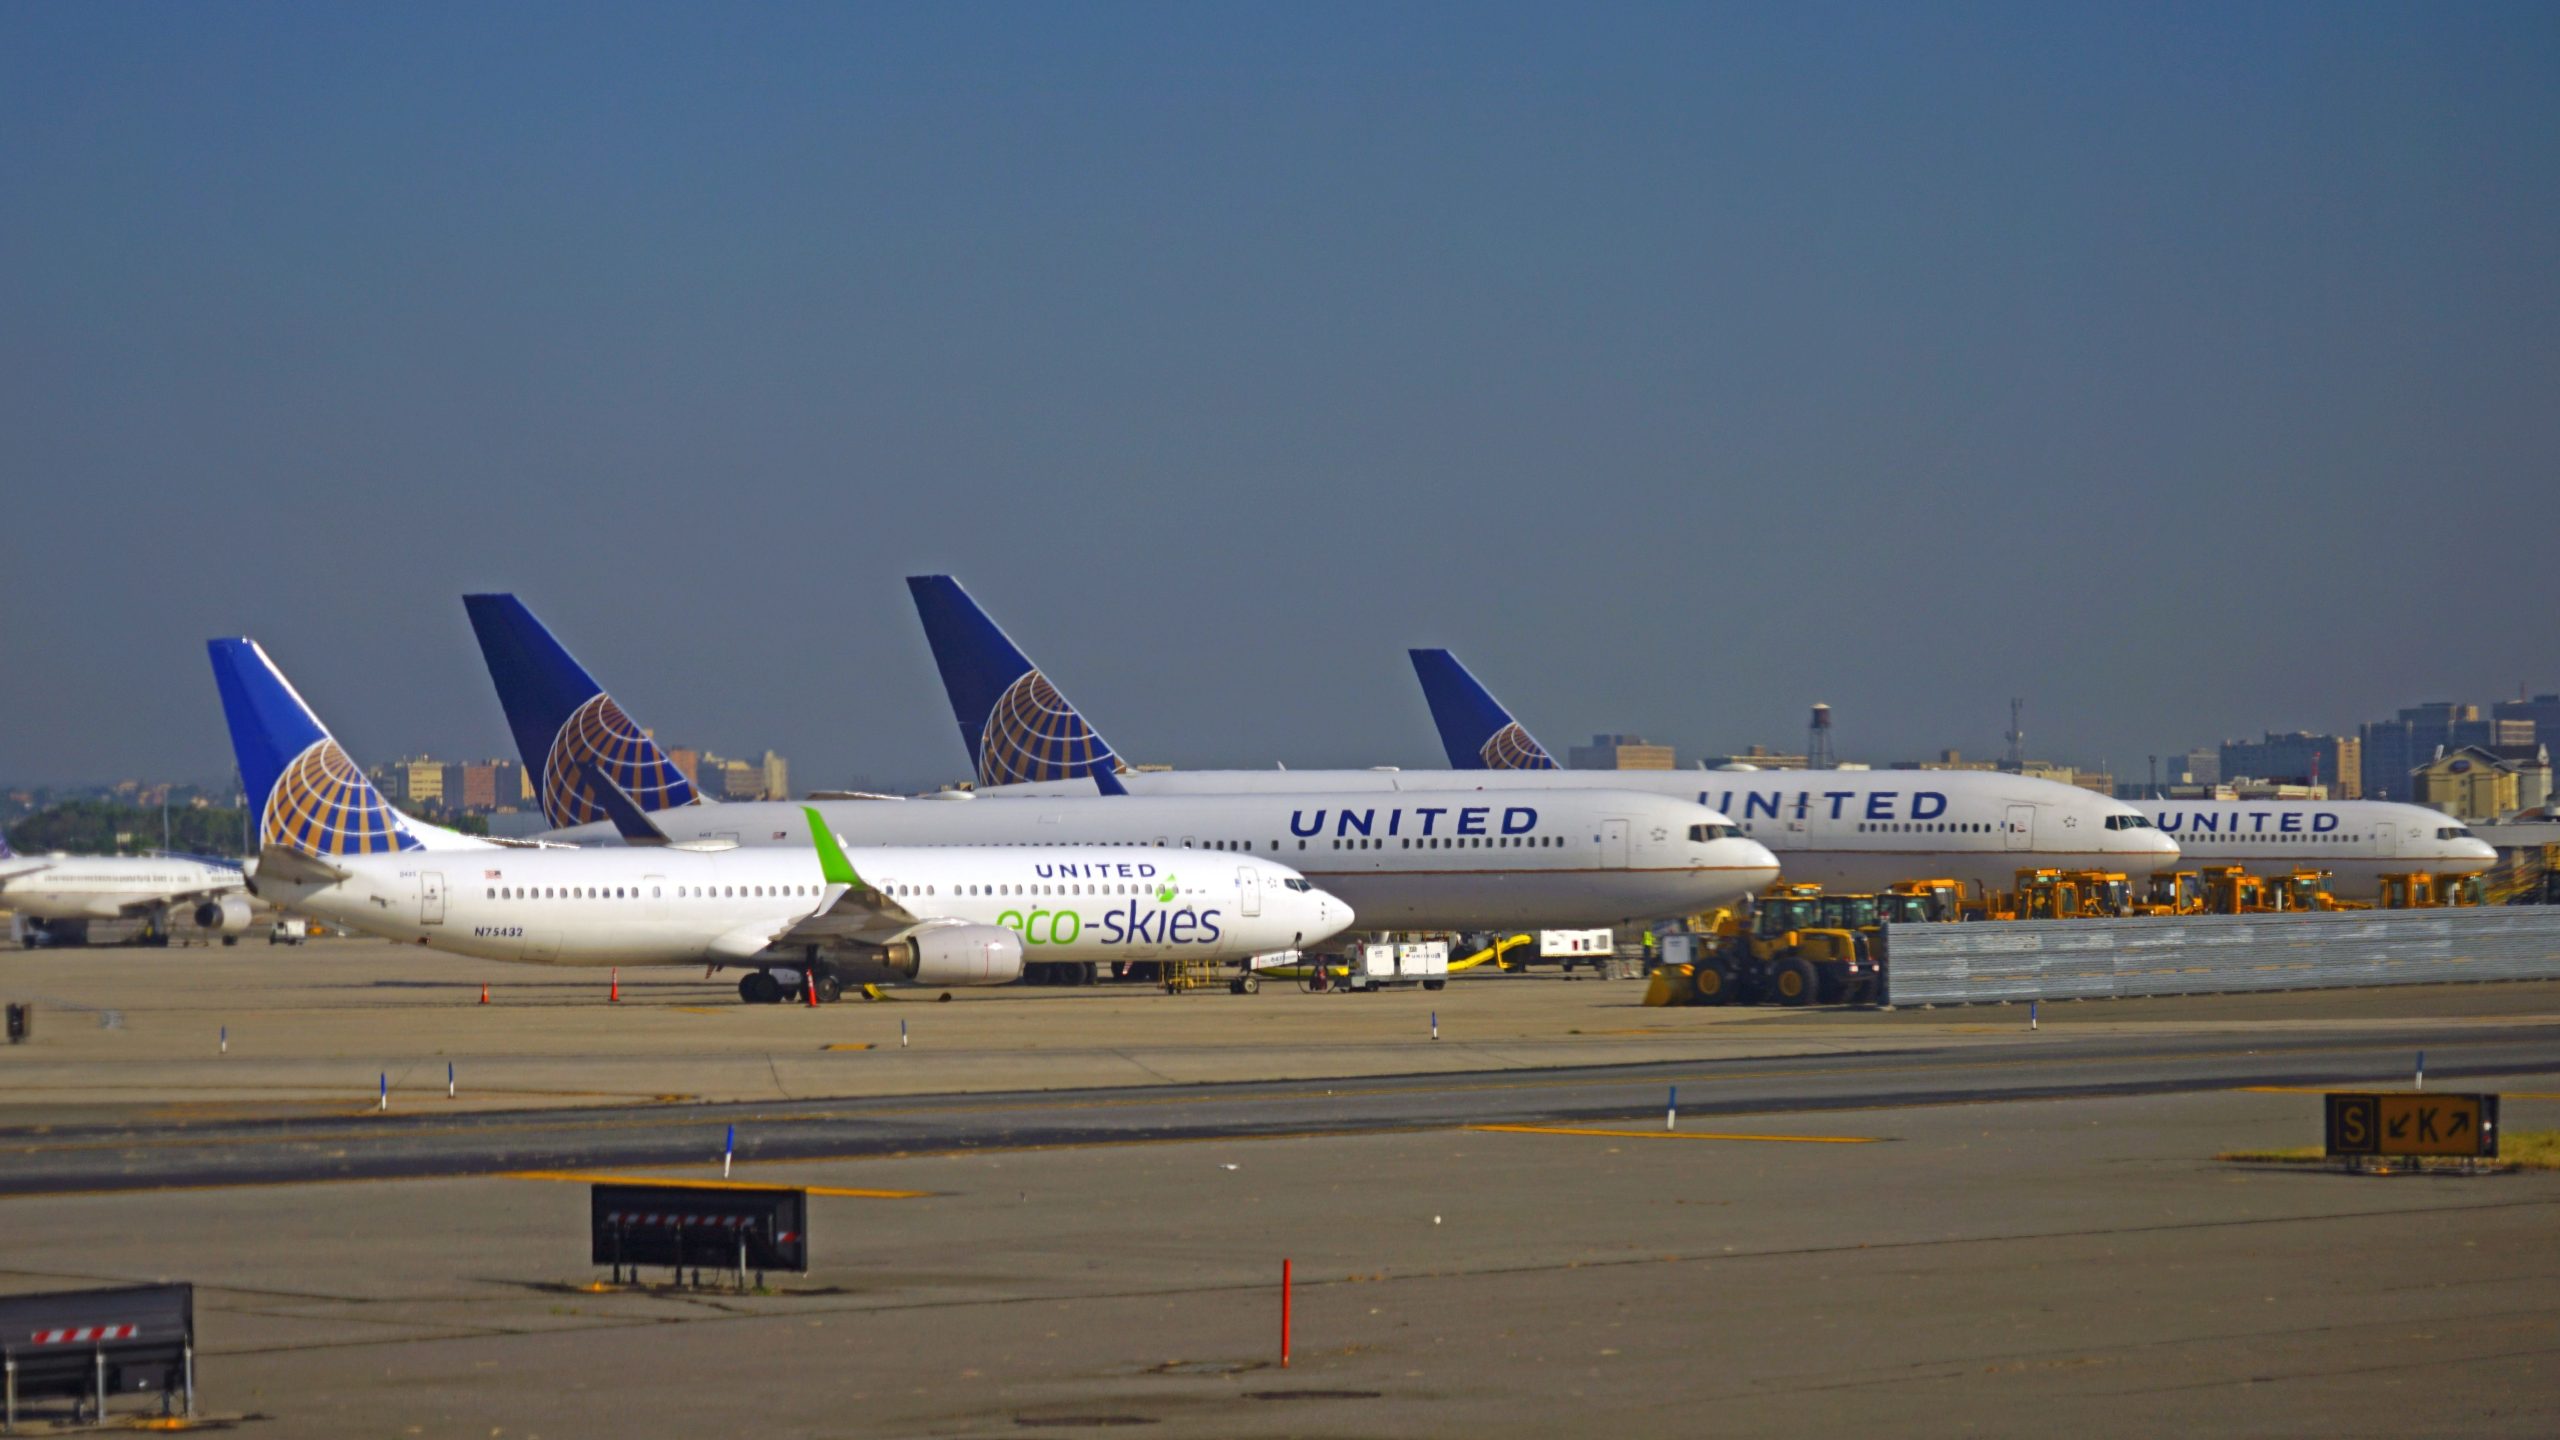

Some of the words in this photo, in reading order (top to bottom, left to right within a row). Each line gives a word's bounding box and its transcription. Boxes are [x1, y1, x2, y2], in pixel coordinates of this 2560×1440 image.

[1697, 791, 1948, 819] UNITED
[1290, 807, 1538, 837] UNITED
[2157, 812, 2339, 832] UNITED
[1035, 864, 1156, 878] UNITED
[475, 927, 523, 937] N75432
[997, 899, 1221, 945] eco-skies
[2344, 1107, 2365, 1143] S
[2419, 1107, 2439, 1143] K
